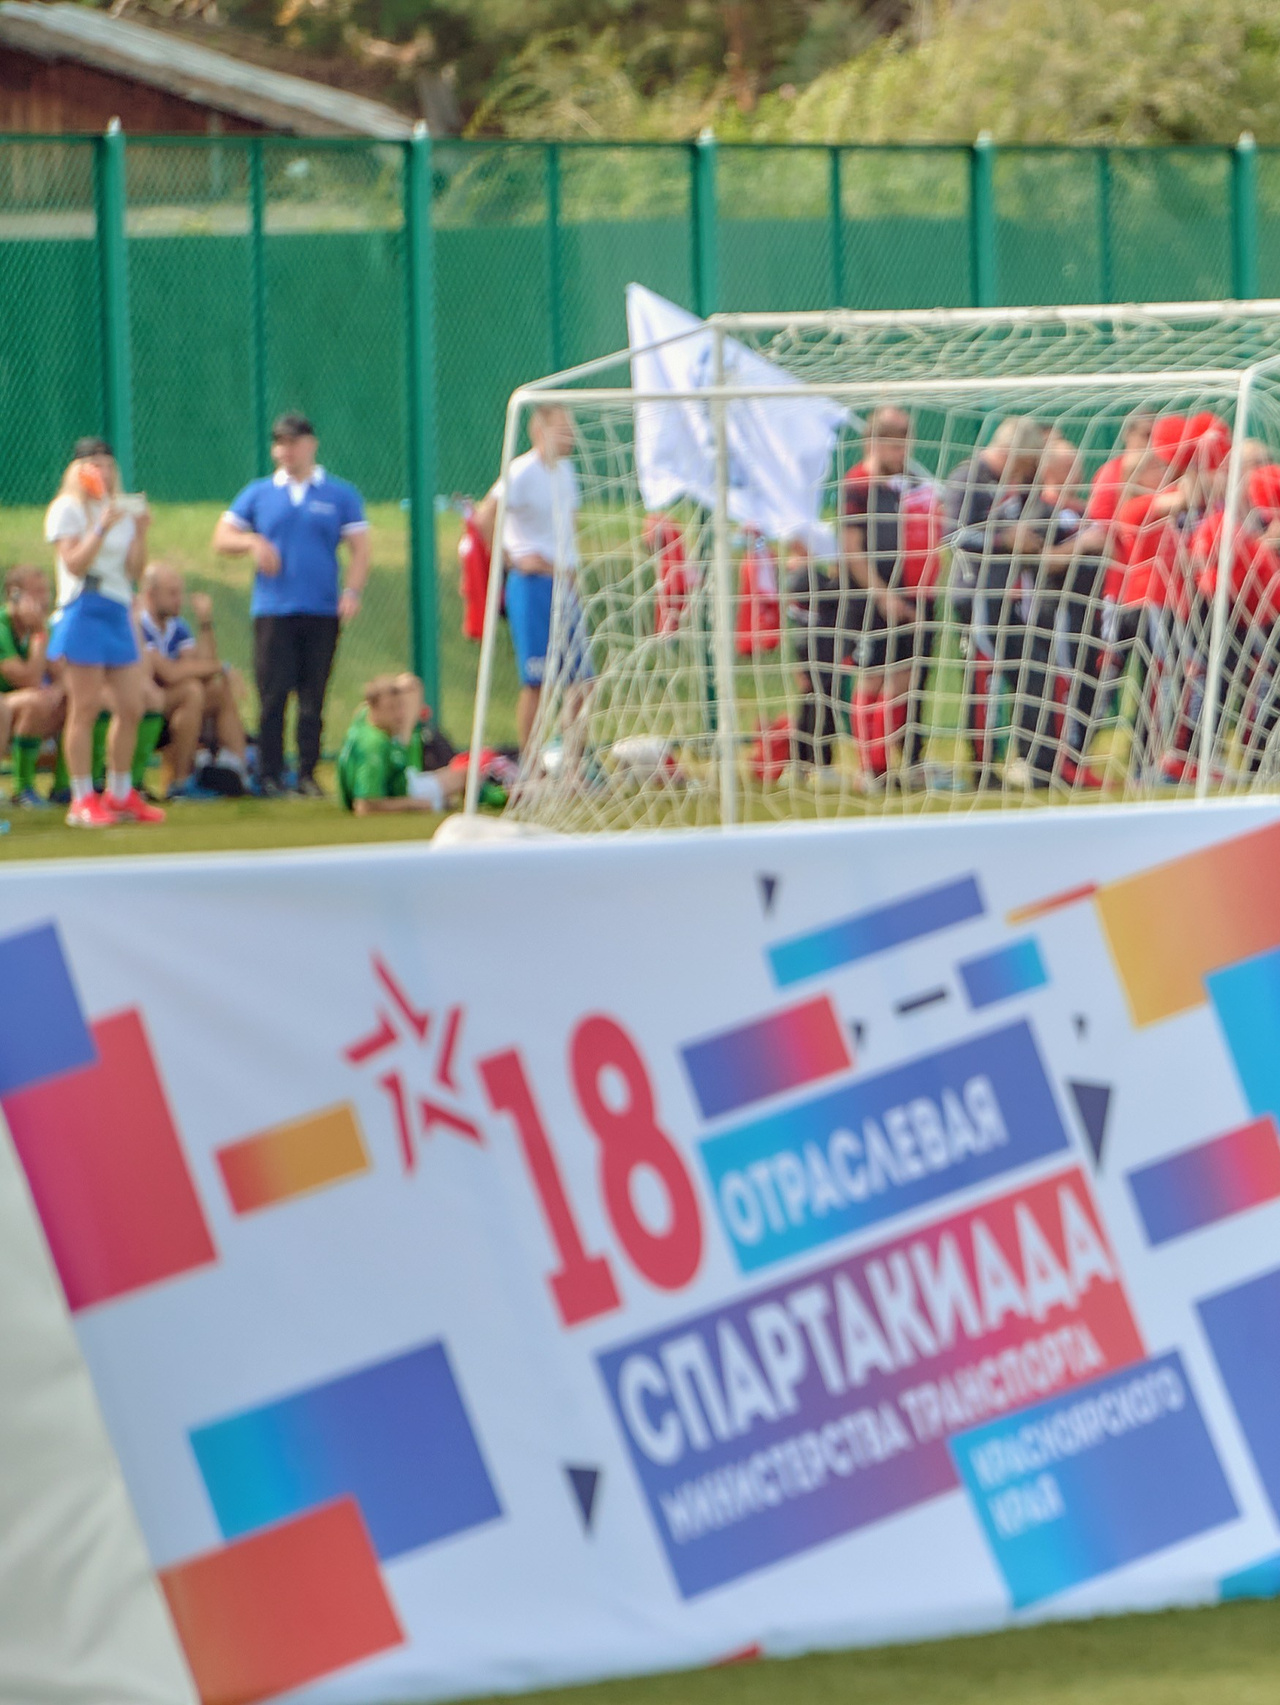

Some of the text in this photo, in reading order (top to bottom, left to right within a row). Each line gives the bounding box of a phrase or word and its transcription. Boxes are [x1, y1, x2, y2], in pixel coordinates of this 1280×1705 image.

[476, 1013, 706, 1330] 18
[718, 1075, 1010, 1246] ОТРАСЛЕВАЯ
[616, 1183, 1117, 1465] СПАРТАКИАДА
[660, 1323, 1106, 1544] МИНИСТЕРСТВА ТРАНСПОРТА
[968, 1366, 1186, 1491] КРАСНОЯРСКОГО
[985, 1473, 1066, 1539] КРАЯ
